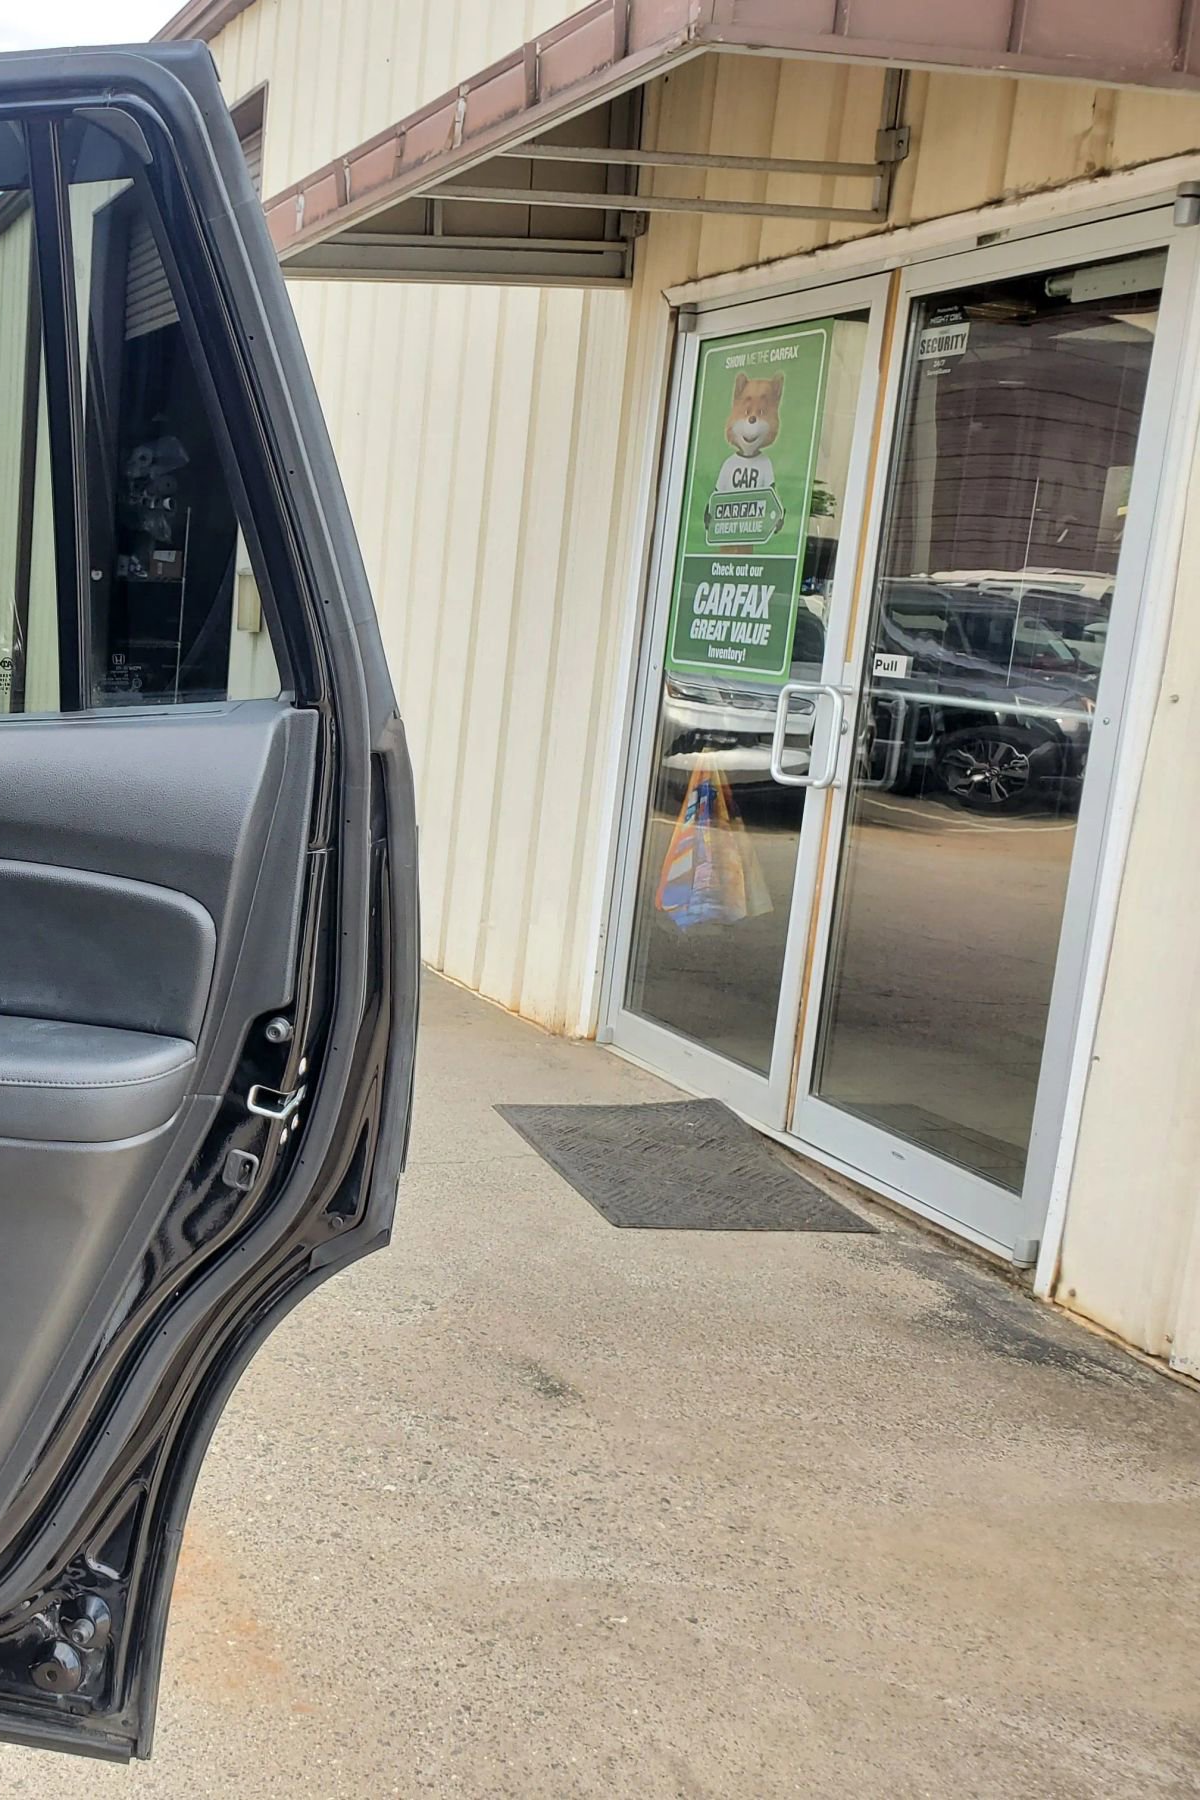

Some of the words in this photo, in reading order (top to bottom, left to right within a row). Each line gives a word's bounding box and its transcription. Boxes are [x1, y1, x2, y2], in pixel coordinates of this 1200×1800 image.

[920, 333, 967, 355] SECURITY
[725, 354, 746, 369] SHOW
[770, 344, 800, 362] CARFAX
[732, 467, 759, 488] CAR
[715, 501, 765, 519] CARFAX
[714, 522, 738, 534] GREAT
[739, 520, 763, 534] VALUE
[711, 562, 735, 577] Check
[735, 563, 749, 577] out
[749, 566, 764, 577] our
[693, 582, 776, 619] CARFAX
[690, 618, 731, 642] GREAT
[730, 621, 772, 646] VALUE
[708, 643, 746, 664] Inventory!
[875, 659, 898, 671] Pull
